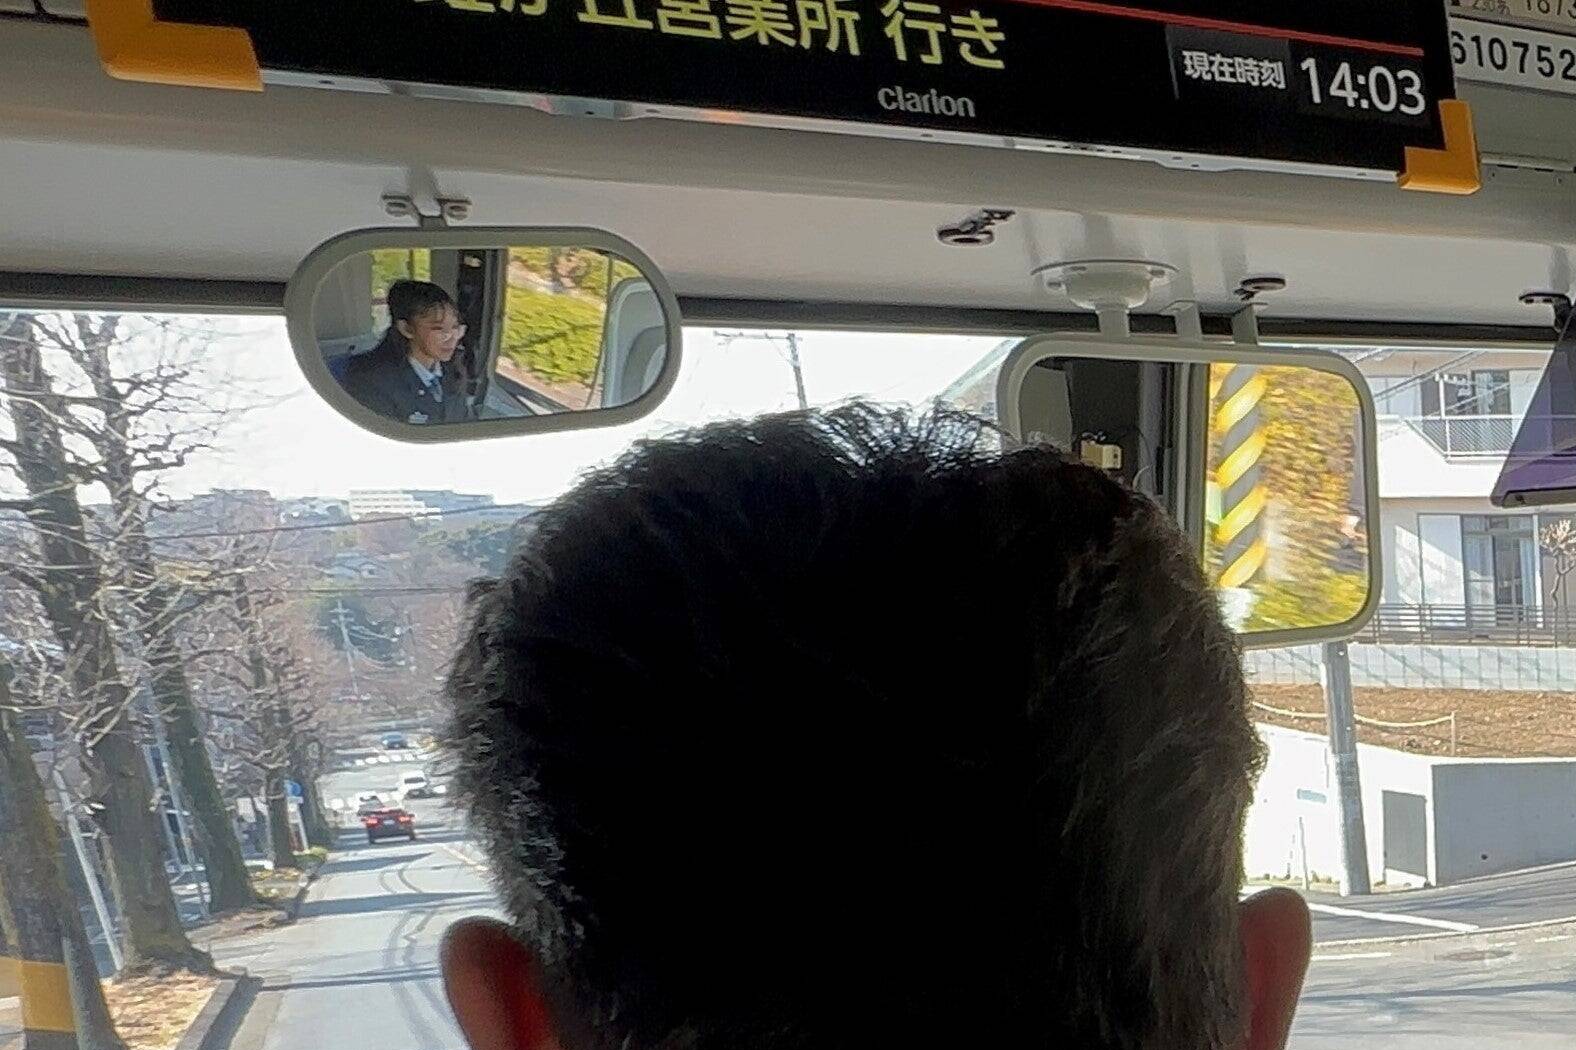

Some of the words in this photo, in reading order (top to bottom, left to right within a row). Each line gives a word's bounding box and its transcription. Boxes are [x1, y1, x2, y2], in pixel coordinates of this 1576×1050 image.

[880, 0, 1006, 69] 行き
[1182, 50, 1287, 89] 現在時刻
[1300, 57, 1427, 115] 14:03
